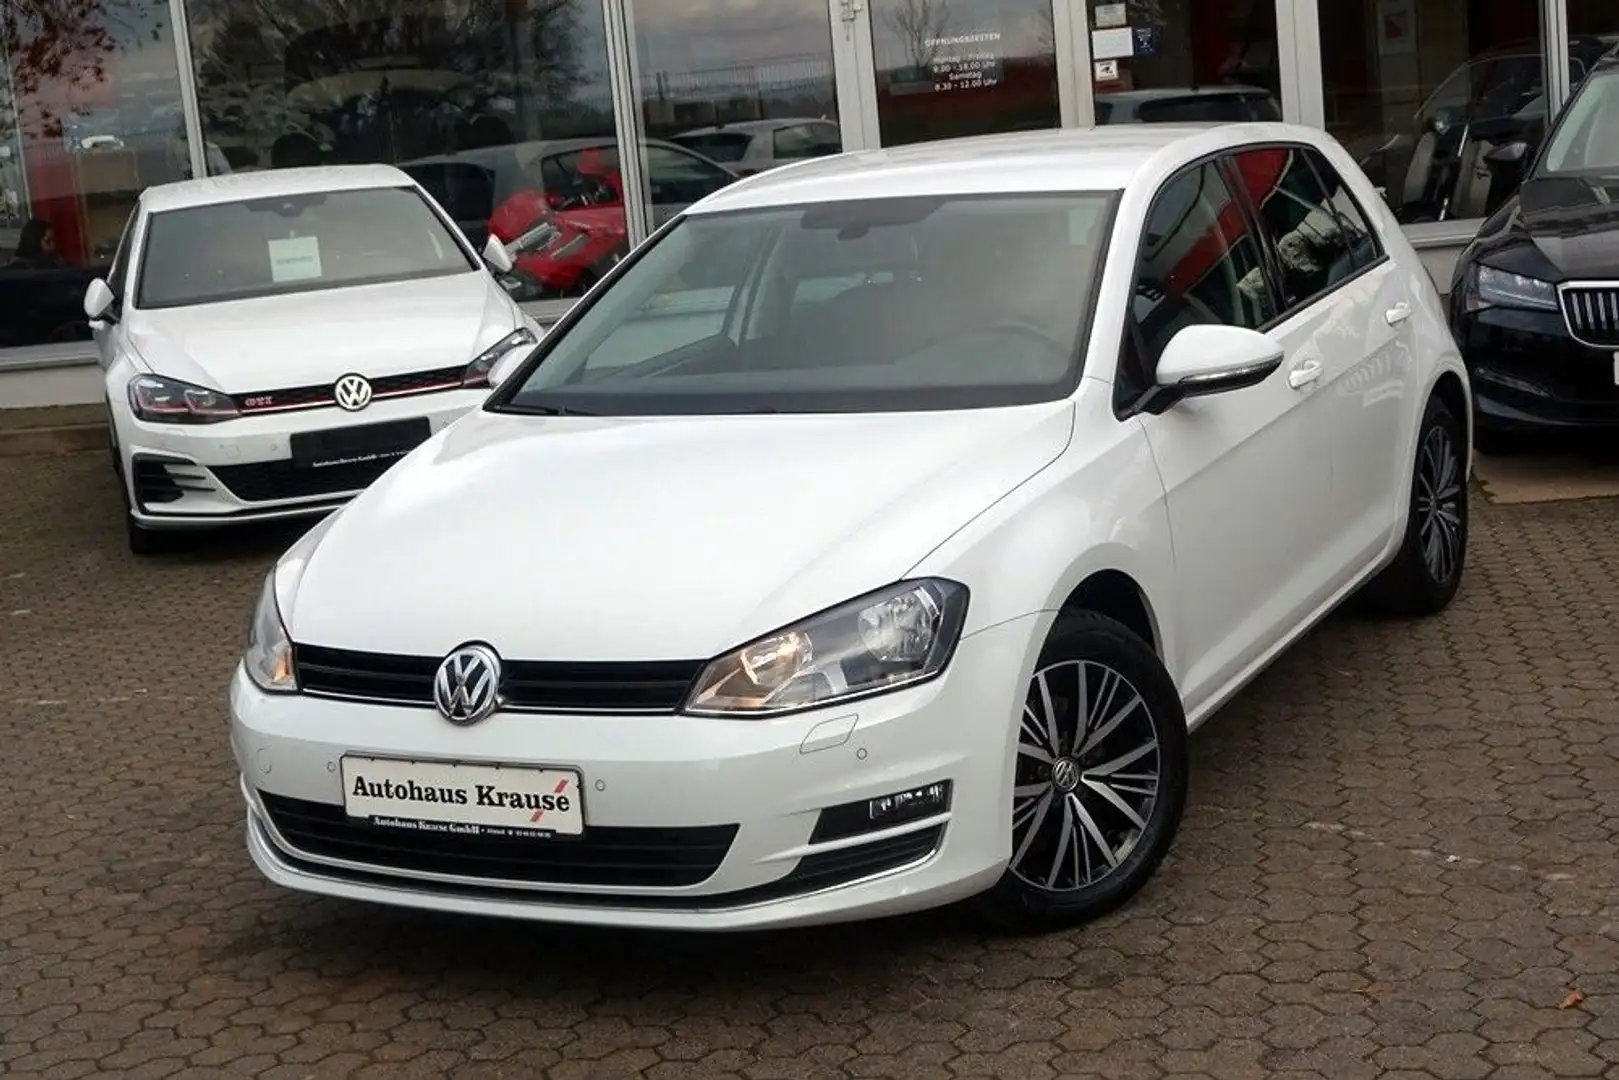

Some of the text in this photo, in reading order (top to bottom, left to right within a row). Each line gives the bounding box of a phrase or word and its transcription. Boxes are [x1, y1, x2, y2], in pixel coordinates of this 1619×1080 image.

[949, 72, 983, 80] Samstag
[960, 80, 982, 89] 12.00
[244, 396, 272, 407] GTI
[353, 775, 570, 812] Autohaus Krause
[373, 816, 417, 829] Autohaus
[449, 823, 480, 834] GmbH
